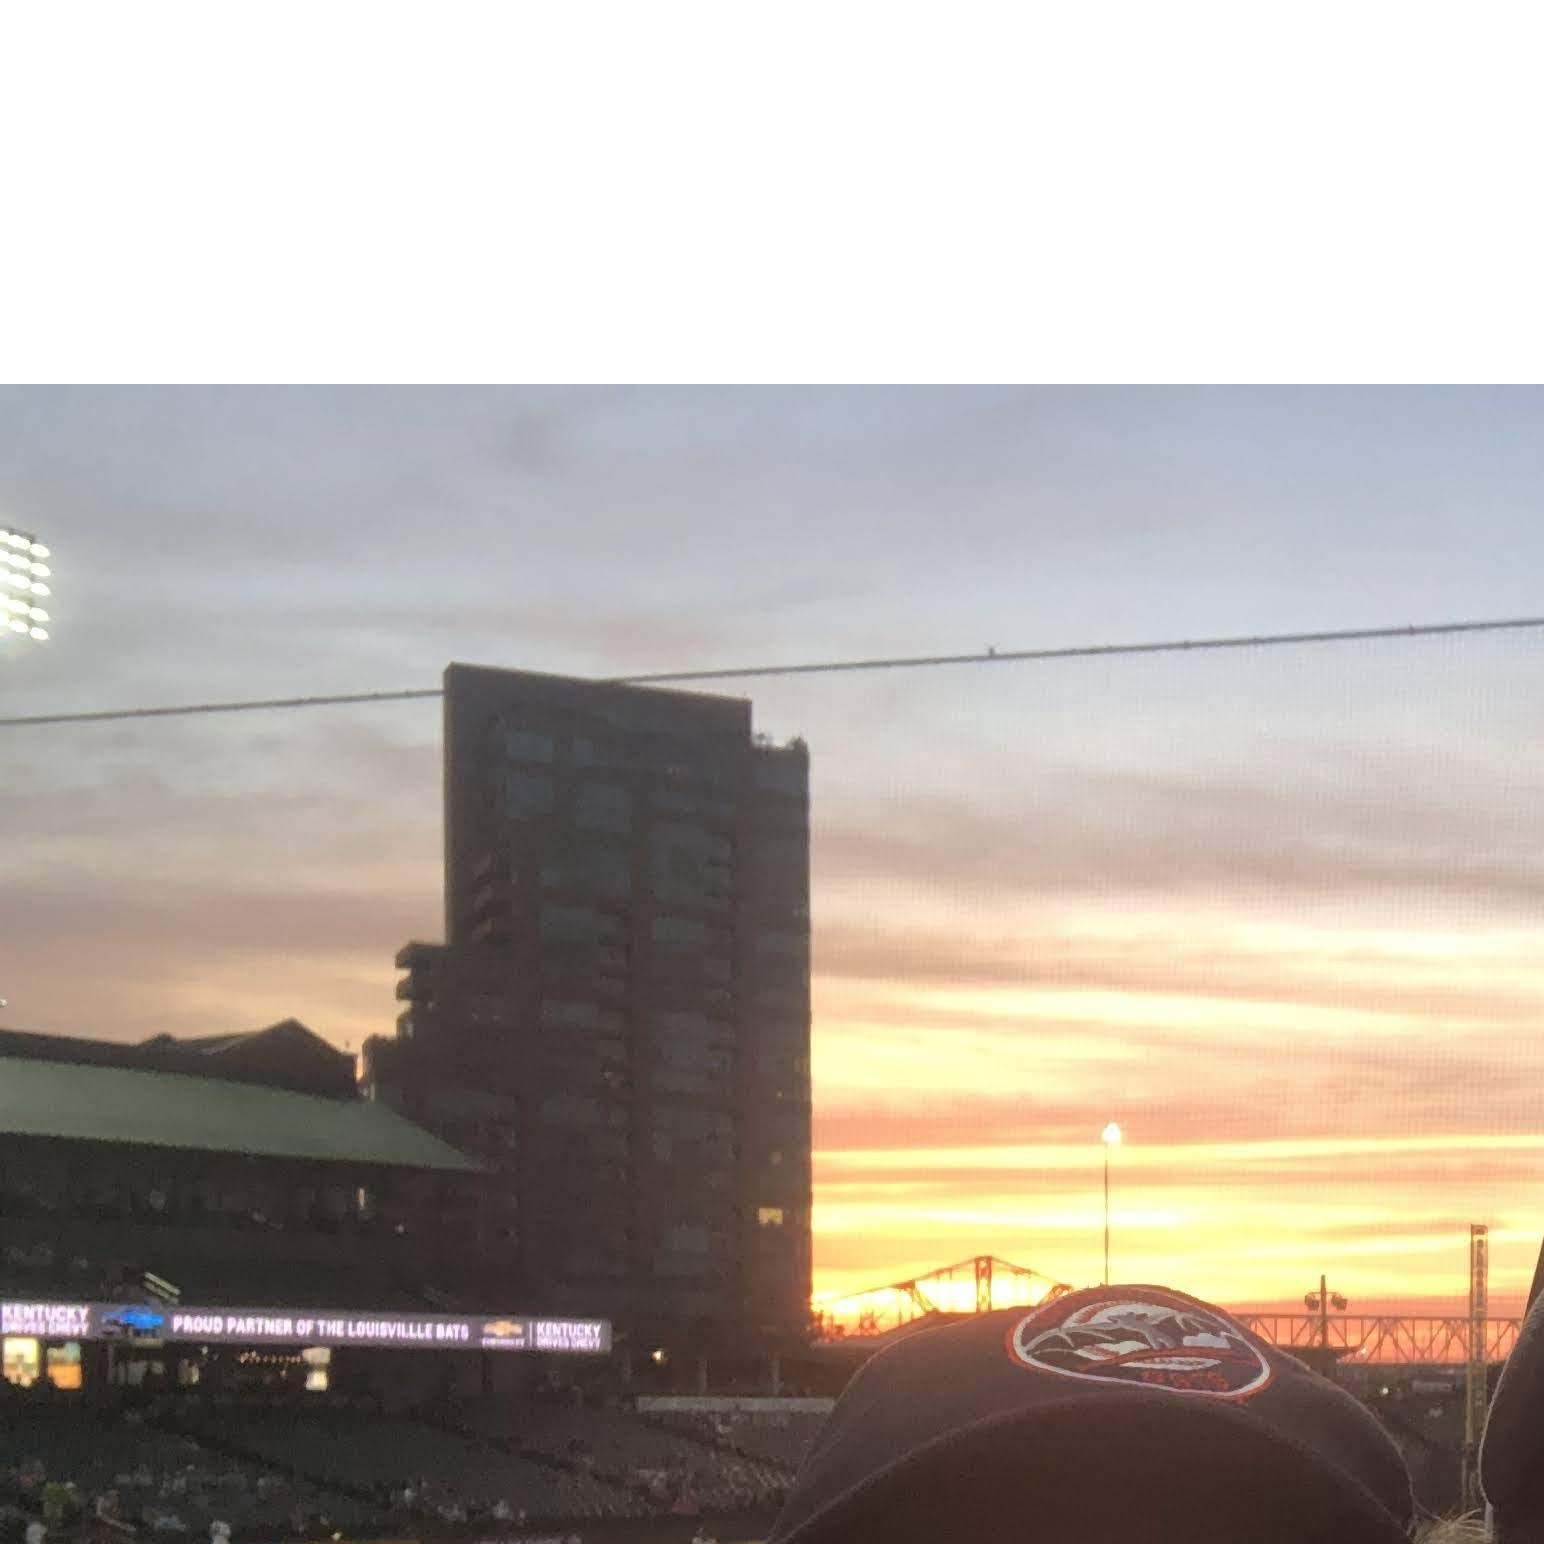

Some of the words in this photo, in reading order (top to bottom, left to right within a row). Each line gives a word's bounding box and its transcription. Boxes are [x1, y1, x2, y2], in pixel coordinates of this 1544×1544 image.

[2, 1303, 89, 1322] KENTUCKY
[172, 1315, 223, 1333] PROUD
[226, 1316, 293, 1336] PARTNER
[295, 1318, 314, 1336] OF
[317, 1319, 345, 1337] THE
[436, 1323, 470, 1340] BATS
[537, 1321, 601, 1338] KENTUCKY
